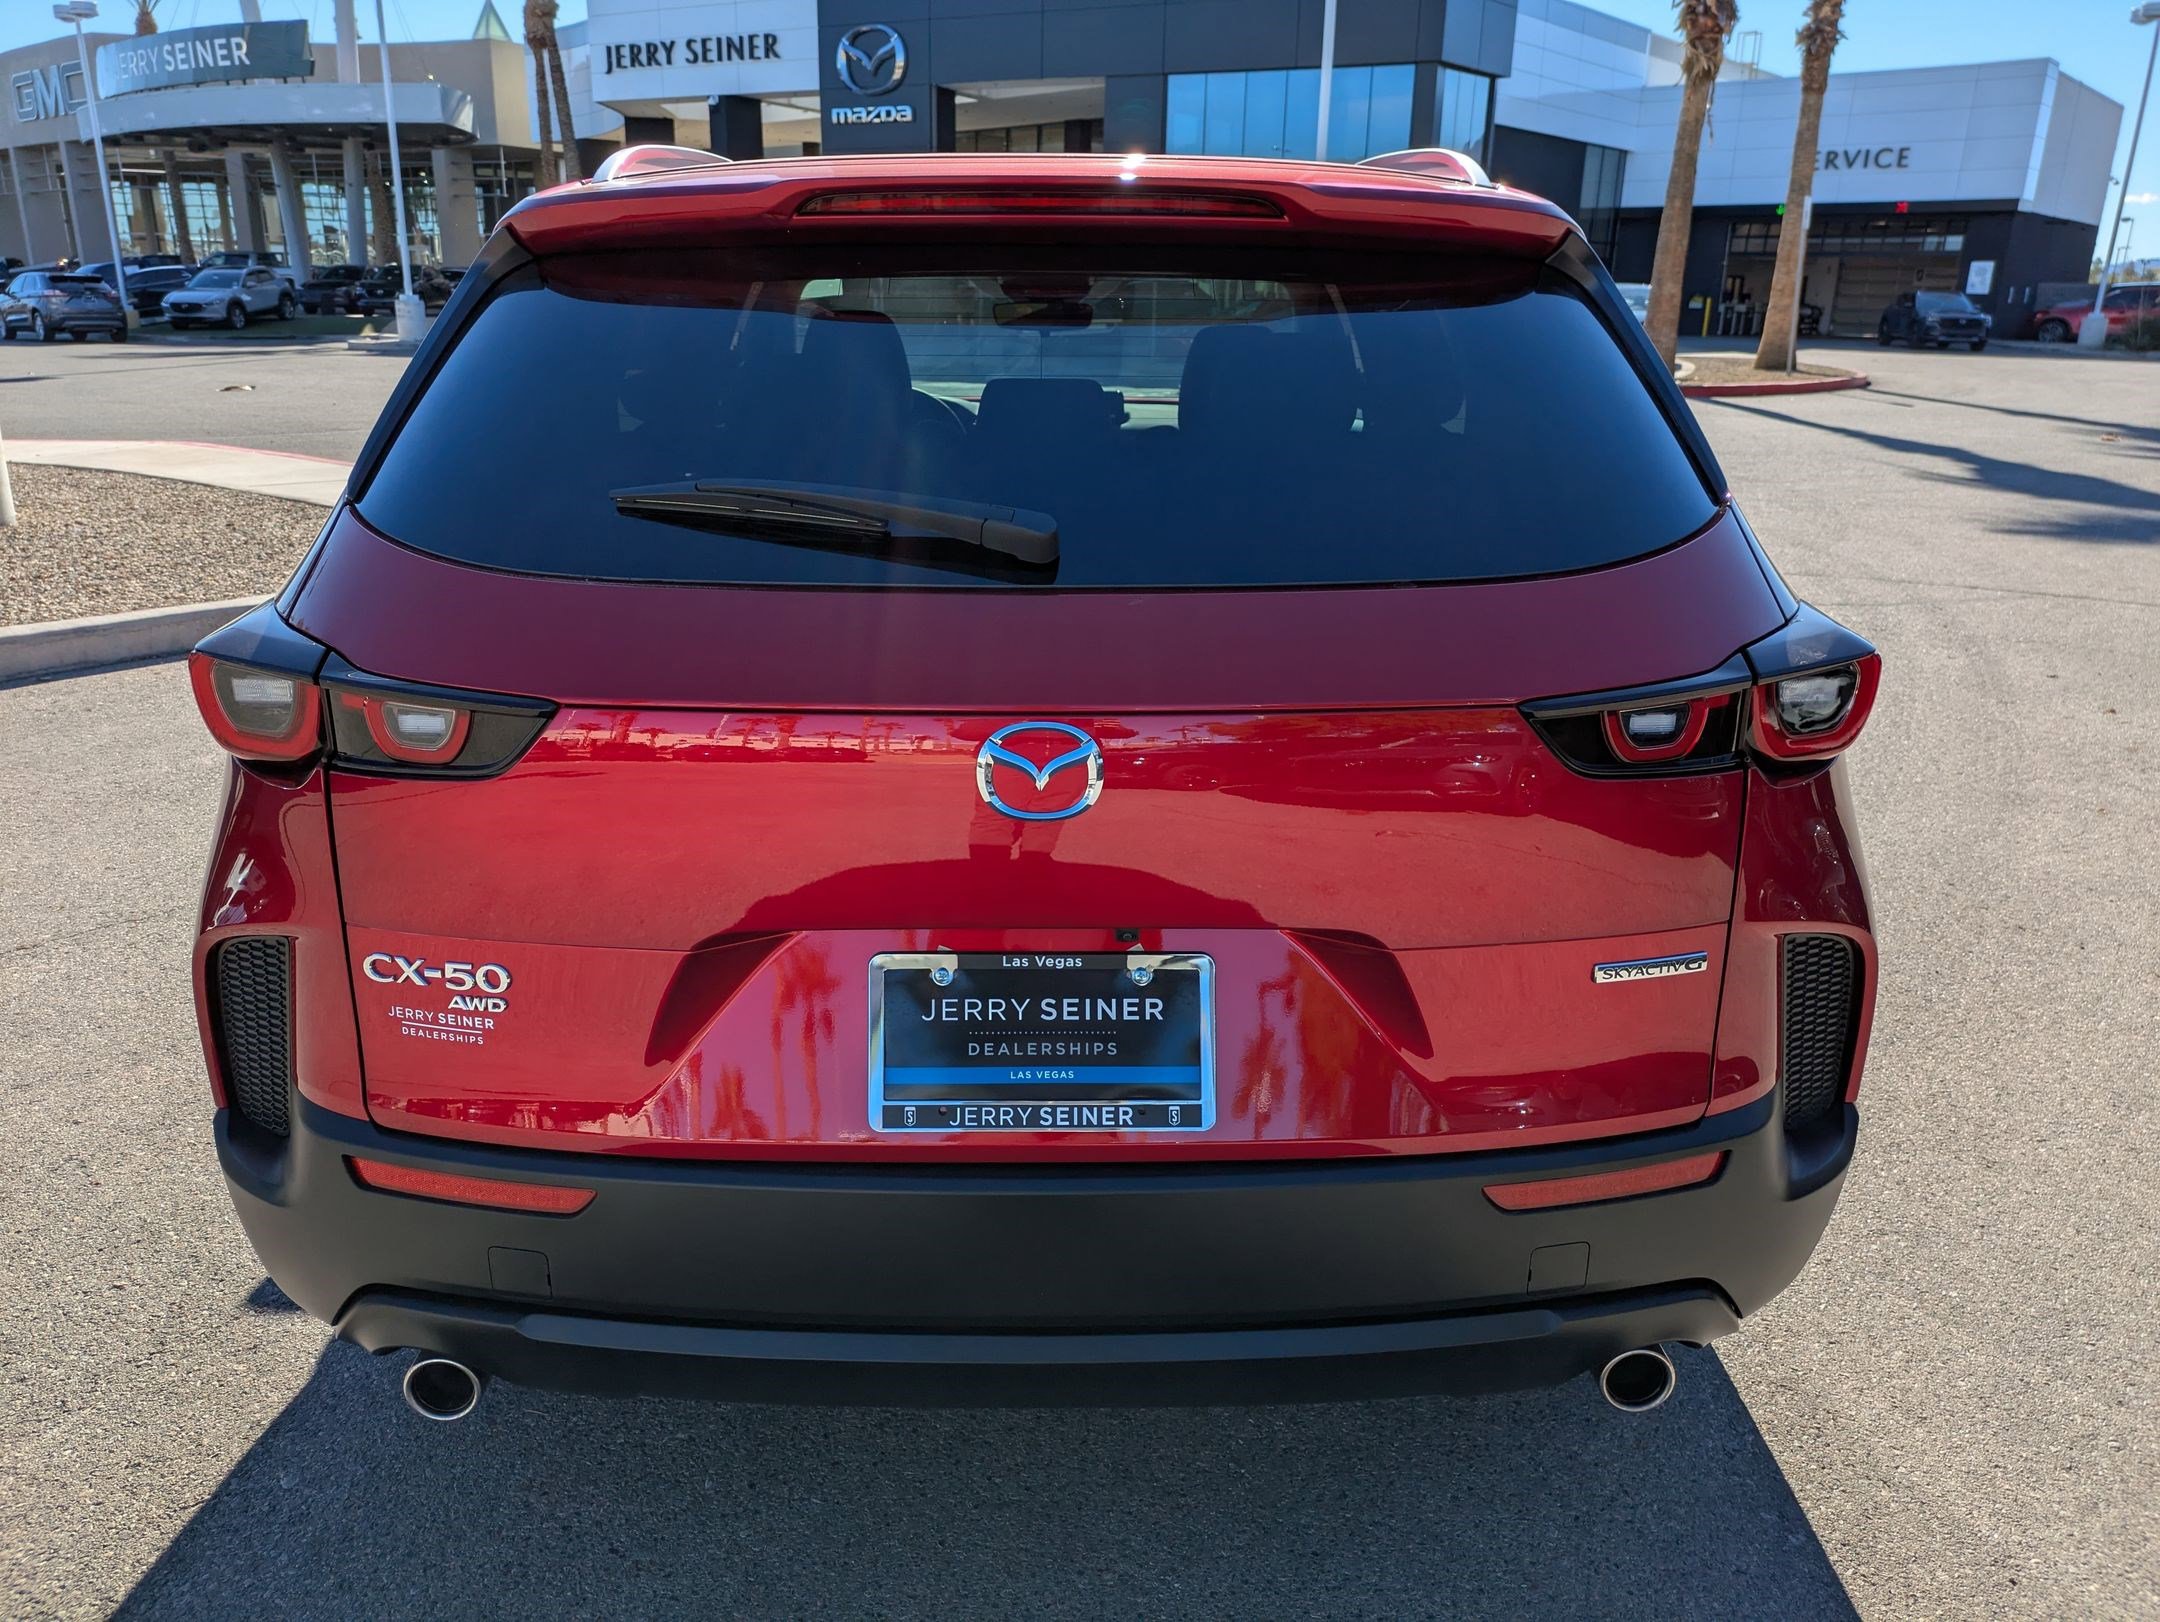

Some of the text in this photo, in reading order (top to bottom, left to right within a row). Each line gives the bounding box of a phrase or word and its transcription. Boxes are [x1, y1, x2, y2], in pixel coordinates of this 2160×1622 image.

[163, 36, 251, 72] SEINER
[604, 32, 782, 75] JERRY SEINER
[11, 59, 89, 123] GMC
[1814, 146, 1911, 172] ERVICE
[362, 951, 513, 995] CX-50
[1002, 955, 1083, 970] Las Vegas
[447, 993, 509, 1013] AWD
[920, 998, 1165, 1022] JERRY SEINER
[388, 1005, 495, 1031] JERRY SEINER
[401, 1026, 485, 1046] DEALERSHIPS
[968, 1042, 1118, 1057] DEALERSHIPS
[1010, 1070, 1075, 1080] LAS VEGAS
[949, 1106, 1134, 1127] JERRY SEINER
